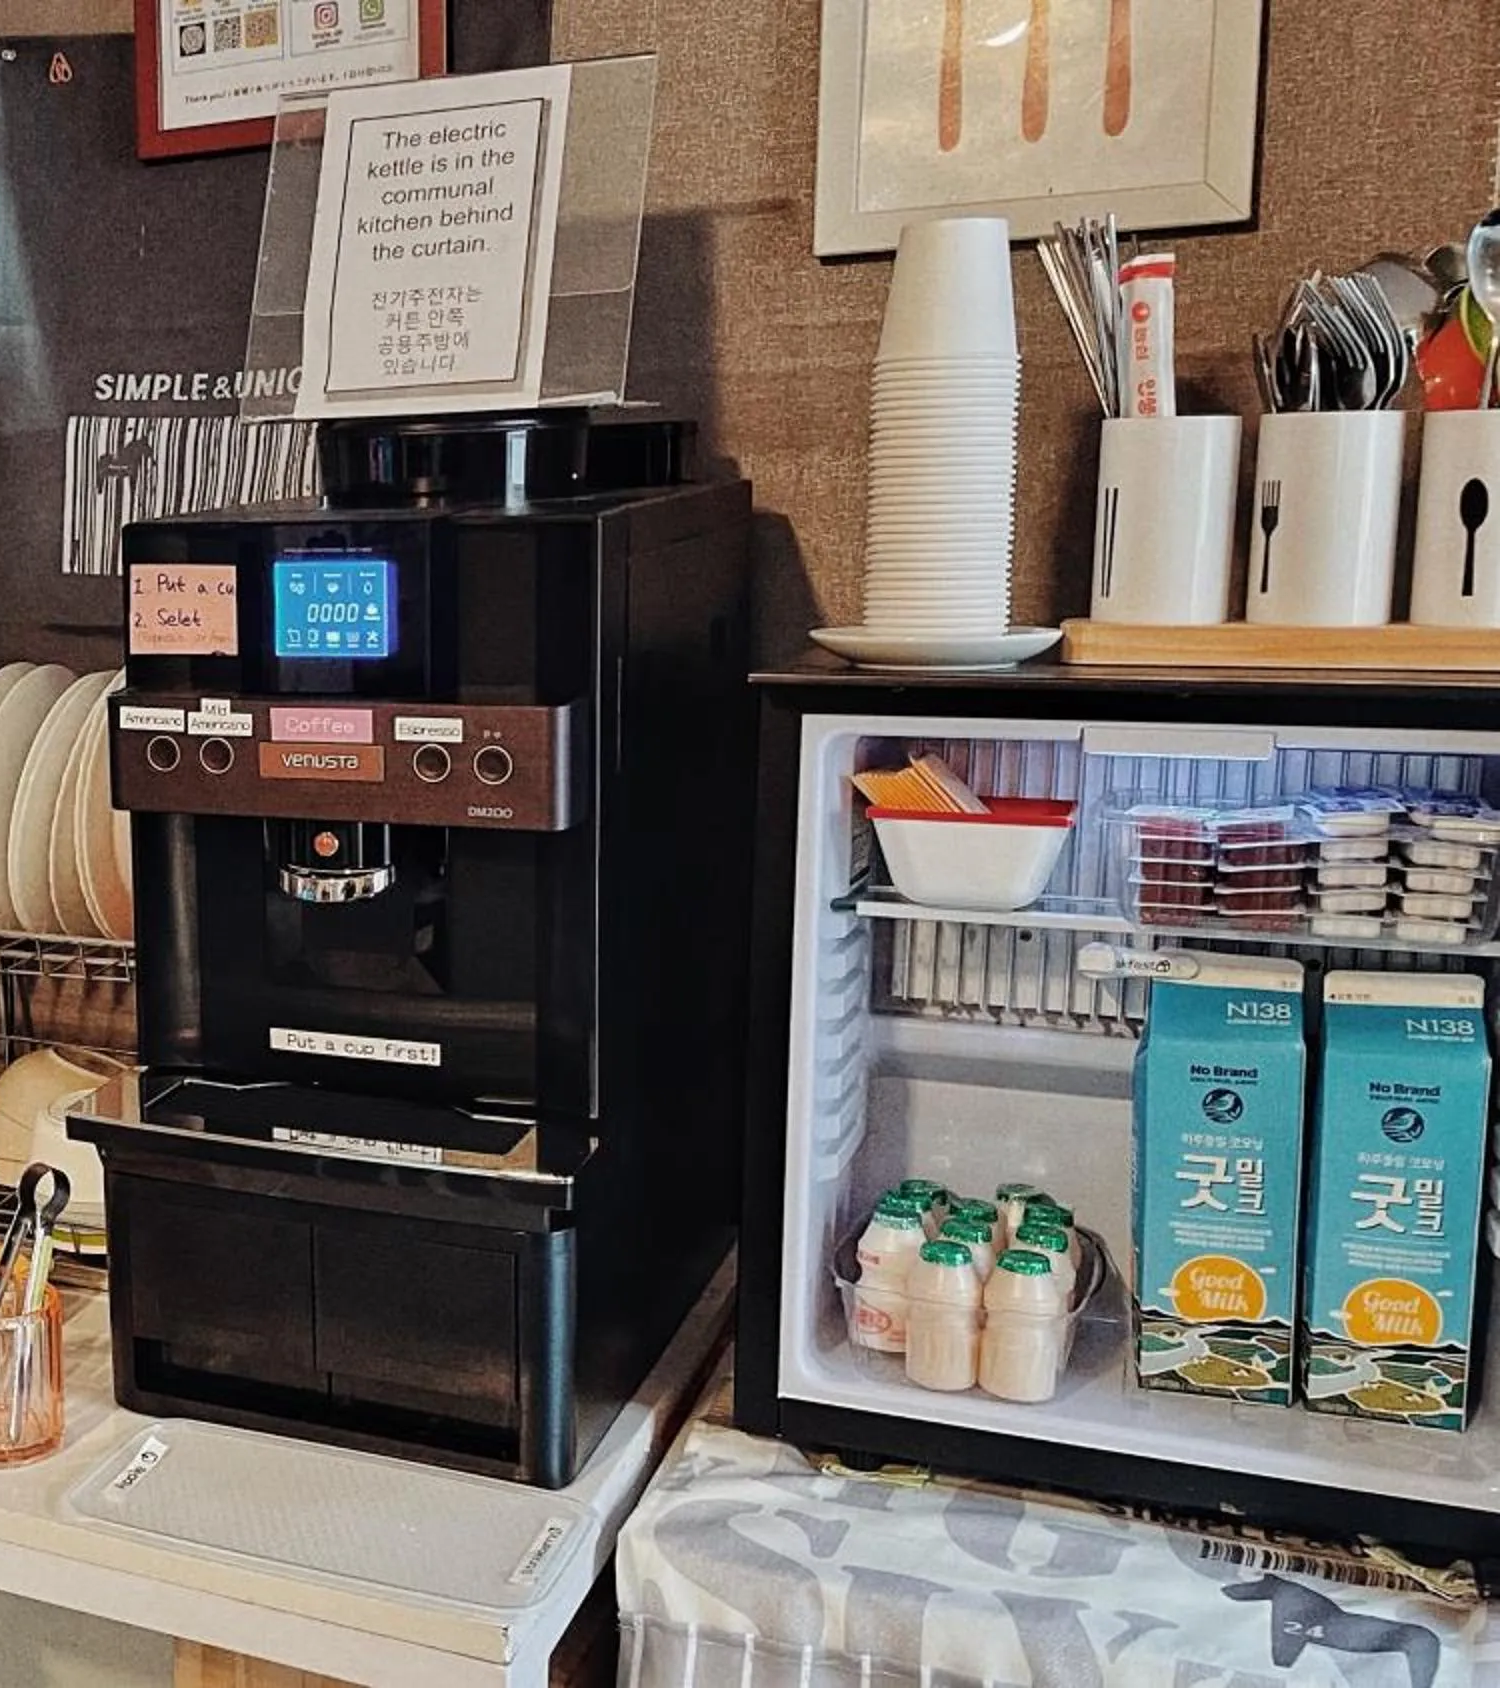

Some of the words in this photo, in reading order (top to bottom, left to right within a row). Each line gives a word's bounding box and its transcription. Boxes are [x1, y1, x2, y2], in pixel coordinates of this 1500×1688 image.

[383, 131, 422, 150] The
[428, 120, 508, 146] electric
[366, 157, 424, 180] kettle
[431, 153, 449, 174] is
[455, 151, 474, 170] in
[481, 148, 516, 168] the
[381, 175, 494, 205] communal
[356, 213, 433, 236] kitchen
[439, 202, 514, 228] behind
[372, 241, 405, 262] the
[411, 236, 491, 258] curtain.
[371, 284, 484, 312] 전기주전자는
[386, 310, 421, 332] 커튼
[378, 331, 470, 356] 공용주방에
[156, 573, 187, 595] Put
[197, 581, 209, 595] a
[307, 603, 359, 623] 0000
[124, 710, 182, 728] Americano
[190, 717, 251, 732] Americano
[285, 716, 356, 735] Coffee
[398, 722, 462, 739] Espresso
[467, 806, 514, 820] DM200
[1227, 1001, 1292, 1020] N138
[1405, 1018, 1476, 1036] N138
[286, 1032, 318, 1051] Put
[325, 1039, 336, 1052] a
[343, 1042, 376, 1057] cup
[385, 1043, 437, 1063] first!
[1189, 1063, 1212, 1077] No
[1213, 1064, 1259, 1080] Brand
[1368, 1081, 1392, 1094] No
[1393, 1082, 1442, 1097] Brand
[1174, 1152, 1235, 1213] 굿
[1349, 1172, 1414, 1234] 굿
[1189, 1266, 1245, 1291] Good
[1198, 1288, 1250, 1314] Milk
[1362, 1290, 1421, 1314] Good
[1371, 1312, 1424, 1337] Milk
[1282, 1620, 1327, 1640] 24
